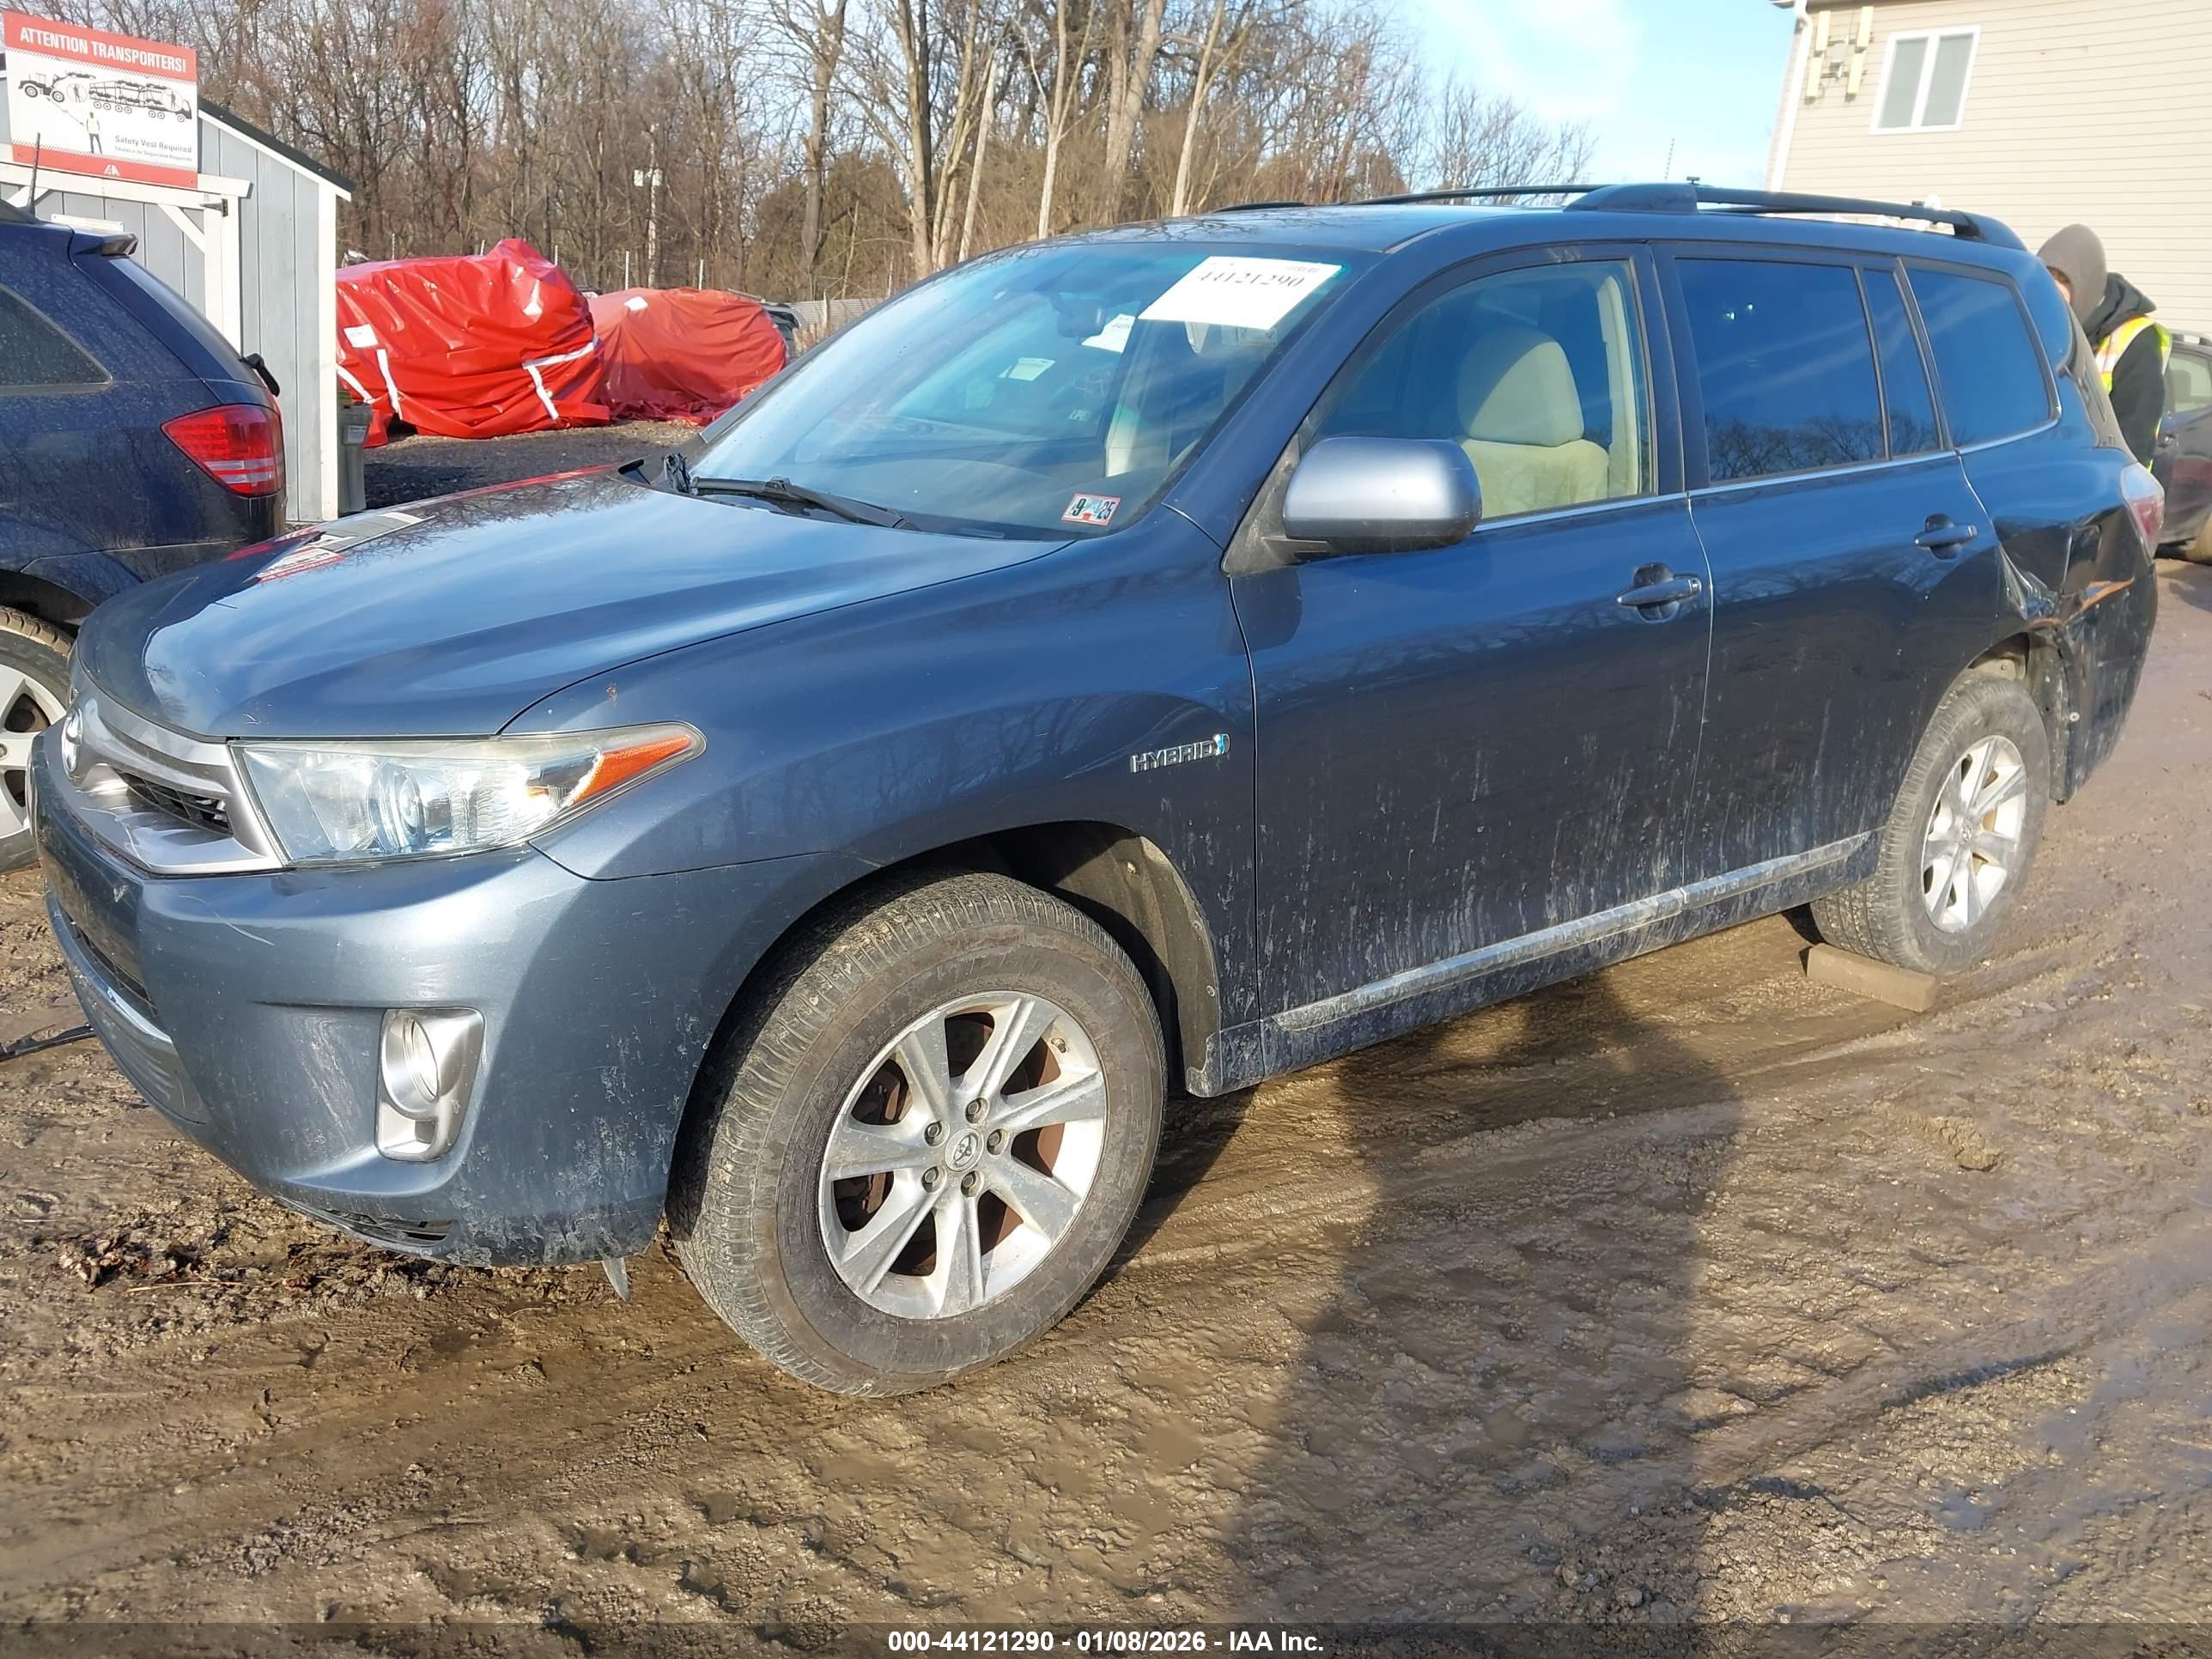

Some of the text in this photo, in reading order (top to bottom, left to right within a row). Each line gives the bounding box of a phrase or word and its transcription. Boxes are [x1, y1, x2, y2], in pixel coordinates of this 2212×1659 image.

[20, 27, 186, 73] ATTENTION TRANSPORTERS!
[115, 135, 191, 153] Safety Vest Required
[1072, 498, 1116, 520] 9 25
[1130, 739, 1216, 774] HYBRID
